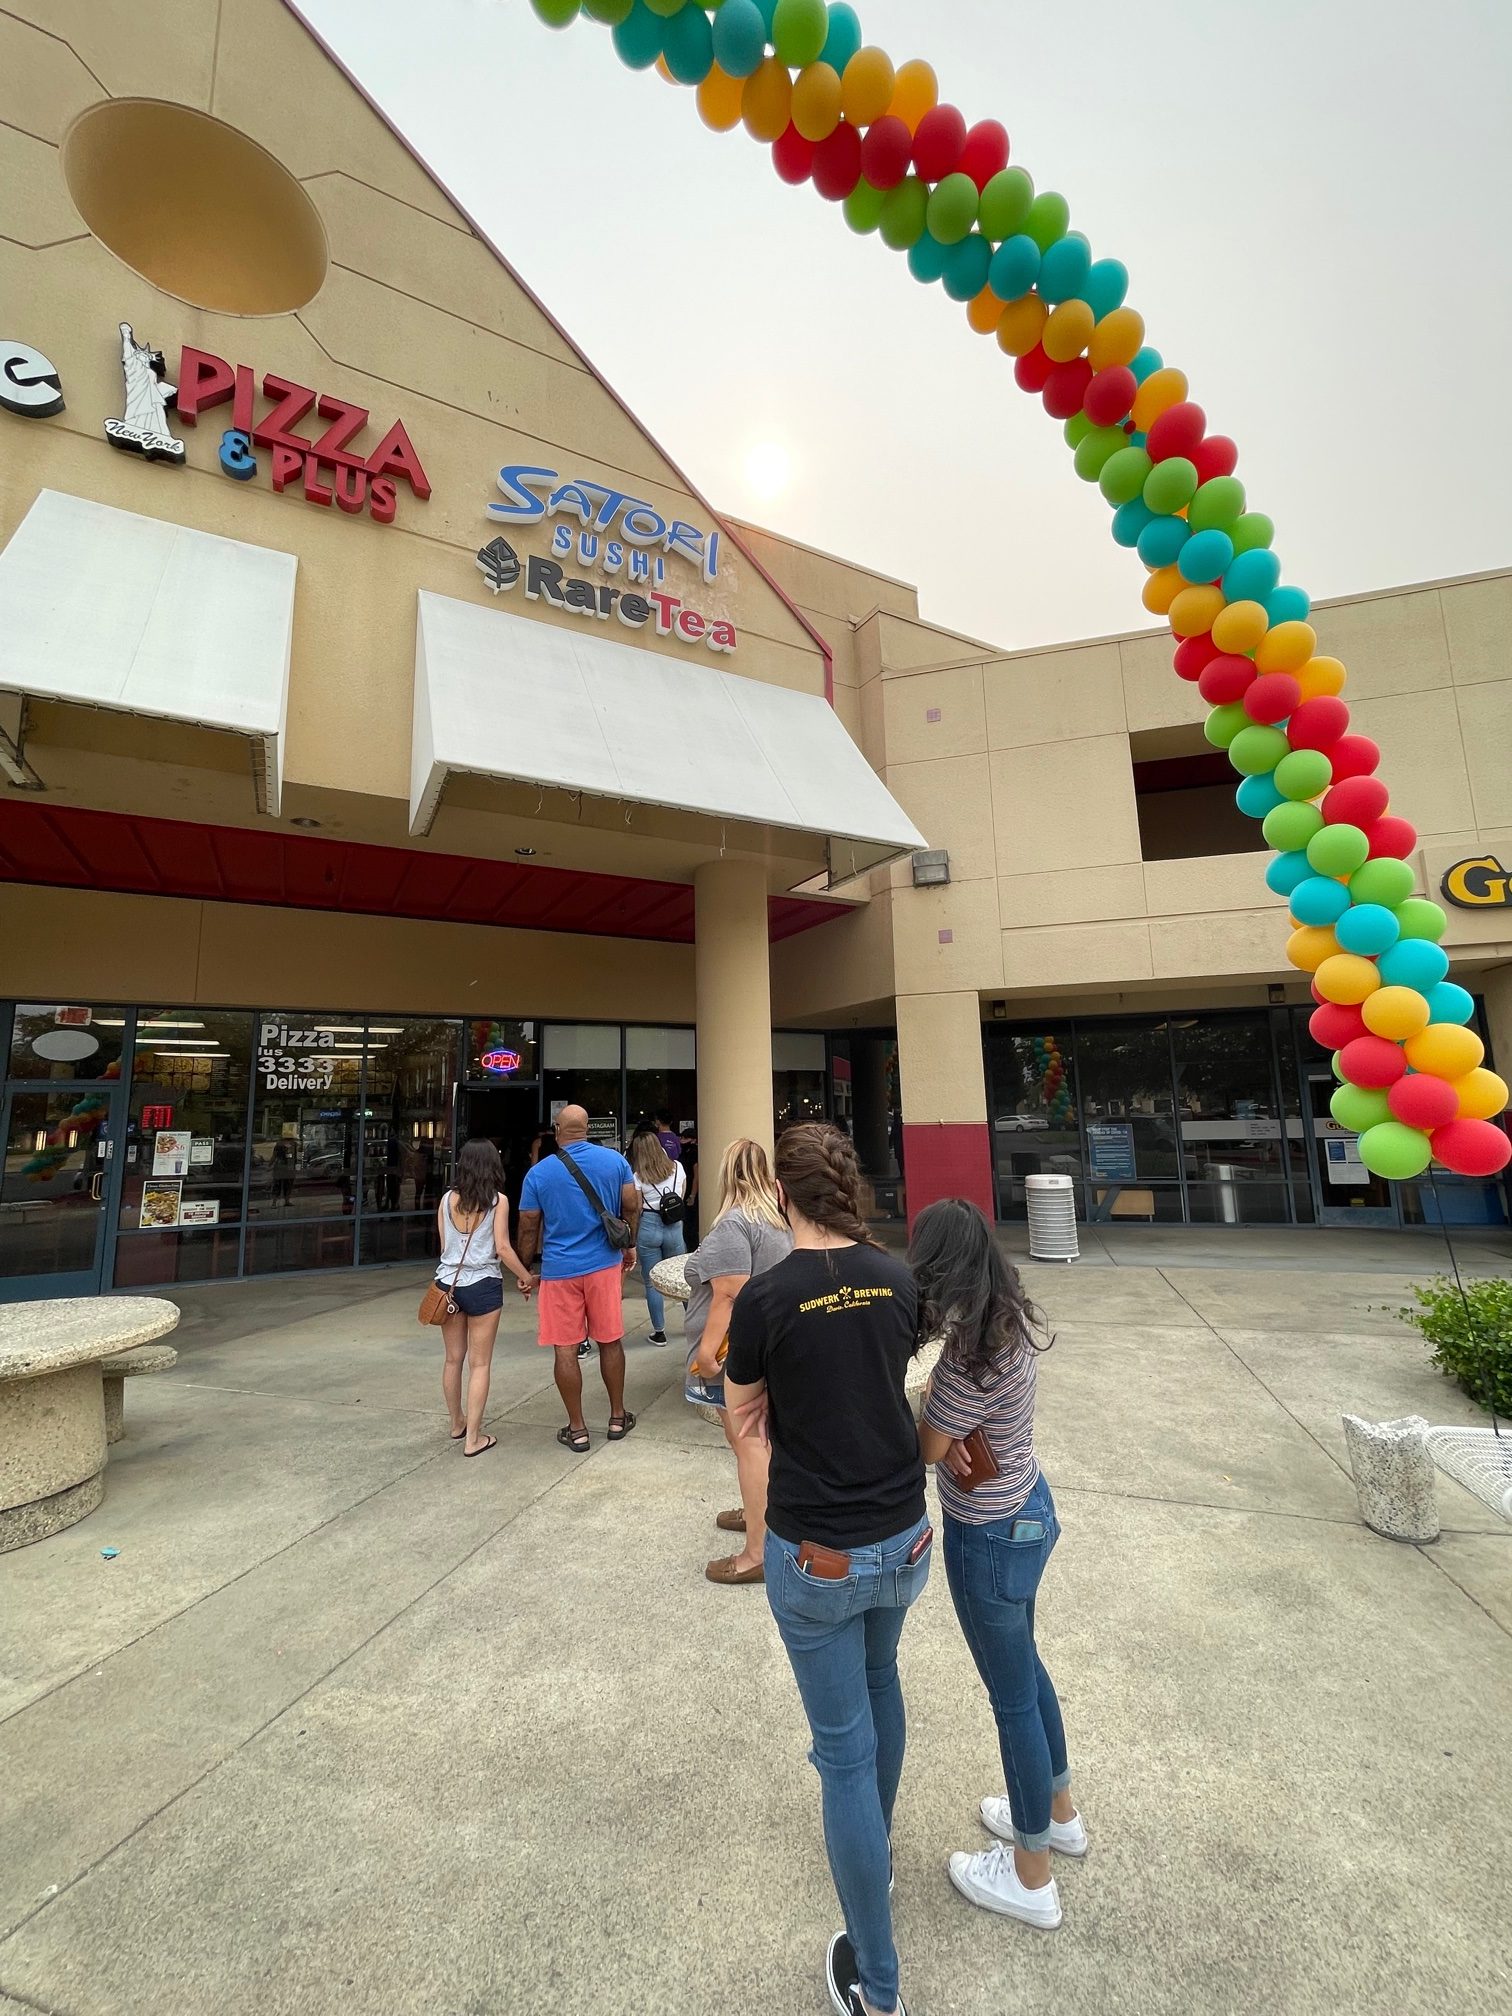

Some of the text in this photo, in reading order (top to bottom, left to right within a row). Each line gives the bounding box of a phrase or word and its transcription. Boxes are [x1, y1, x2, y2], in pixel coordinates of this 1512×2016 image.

[107, 421, 181, 452] New York
[176, 345, 431, 501] PIZZA
[272, 443, 397, 523] PLUS
[487, 465, 719, 585] SATORI
[551, 524, 665, 587] SUSHI
[1446, 857, 1512, 905] G
[260, 1024, 335, 1048] Pizza
[257, 1056, 336, 1073] 3333
[481, 1053, 521, 1069] OPEN
[266, 1073, 333, 1090] Delivery
[799, 1288, 893, 1312] SUDWERK BREWING
